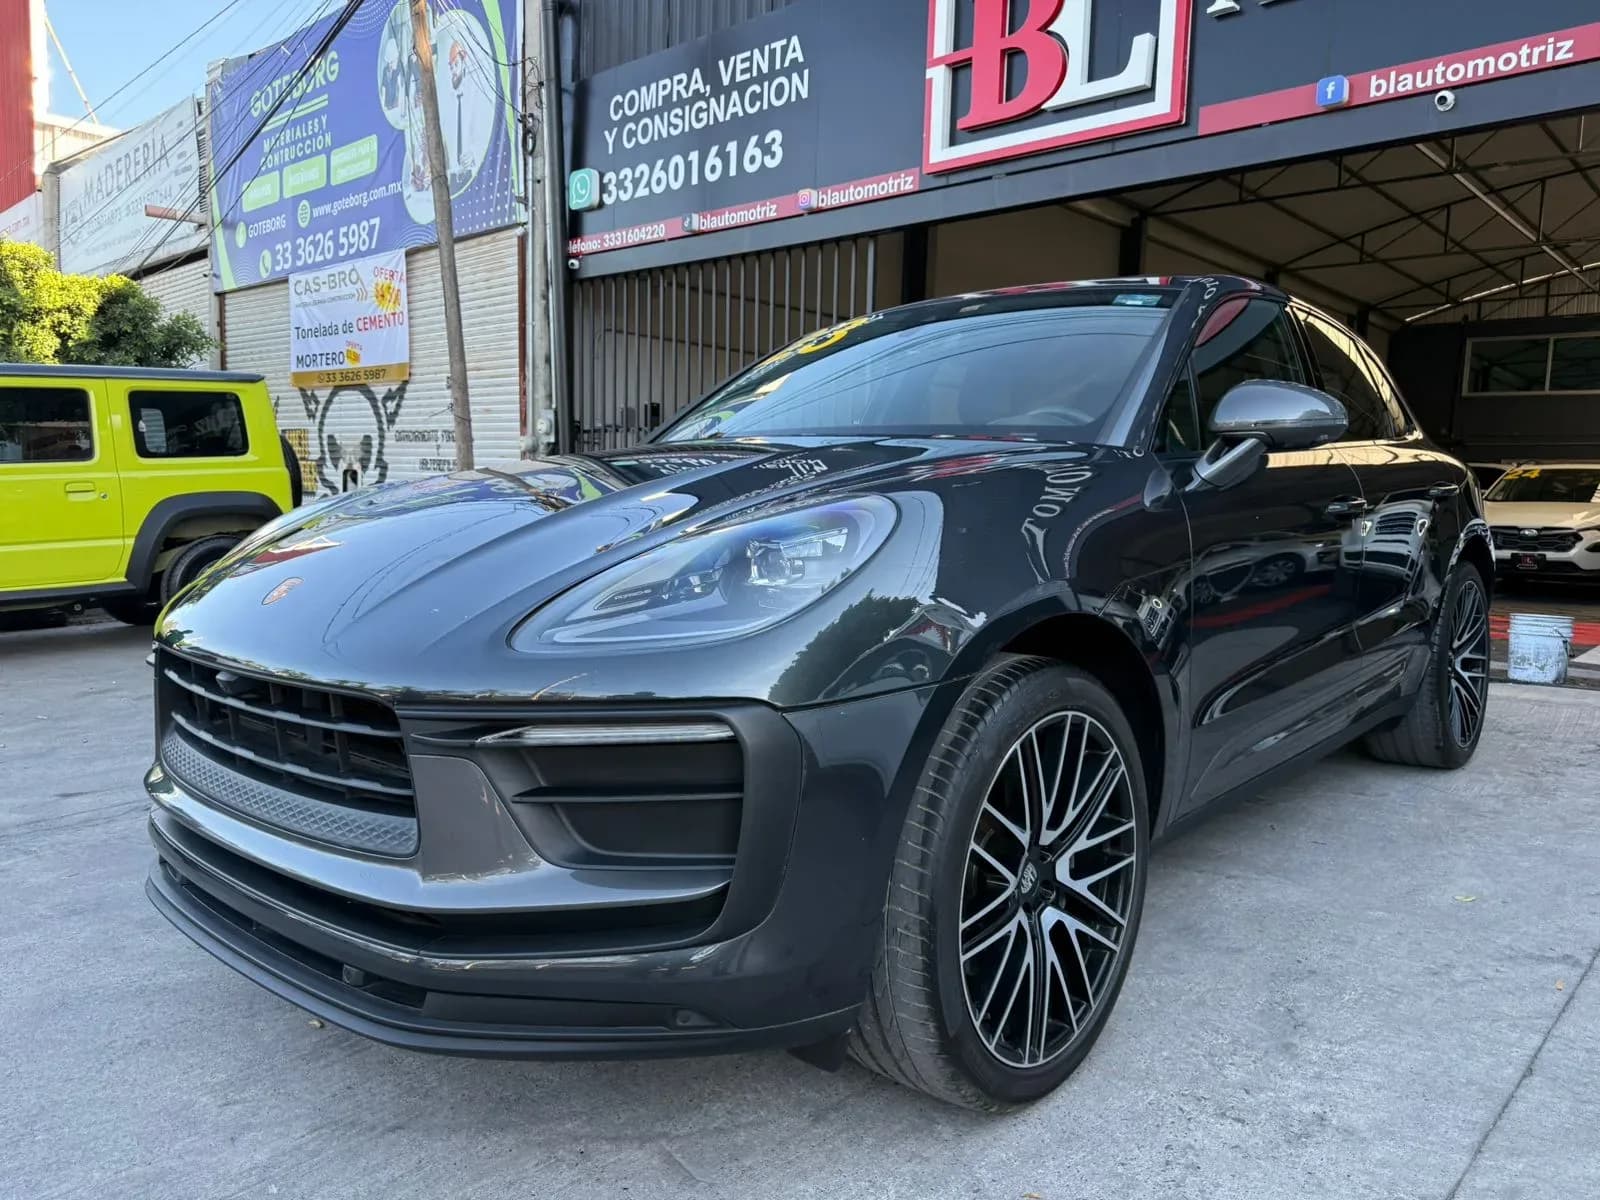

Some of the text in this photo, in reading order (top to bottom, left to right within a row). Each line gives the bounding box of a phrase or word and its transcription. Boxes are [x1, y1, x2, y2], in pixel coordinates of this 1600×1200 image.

[609, 35, 805, 121] COMPRA, VENTA
[1369, 37, 1575, 98] blautomotriz
[604, 69, 809, 154] Y CONSIGNACION
[263, 113, 328, 153] MATERIALES Y
[602, 129, 784, 205] 3326016163
[248, 181, 403, 239] GOTEBORG www.goteborg.com.mx
[818, 174, 914, 207] blautomotriz
[700, 203, 777, 230] blautomotriz
[275, 216, 381, 271] 33 3626 5987
[568, 224, 665, 254] léfono: 3331604220
[294, 312, 404, 340] Tonelada de CEMENTO
[296, 351, 344, 368] MORTERO
[325, 369, 386, 383] 33 3626 5987
